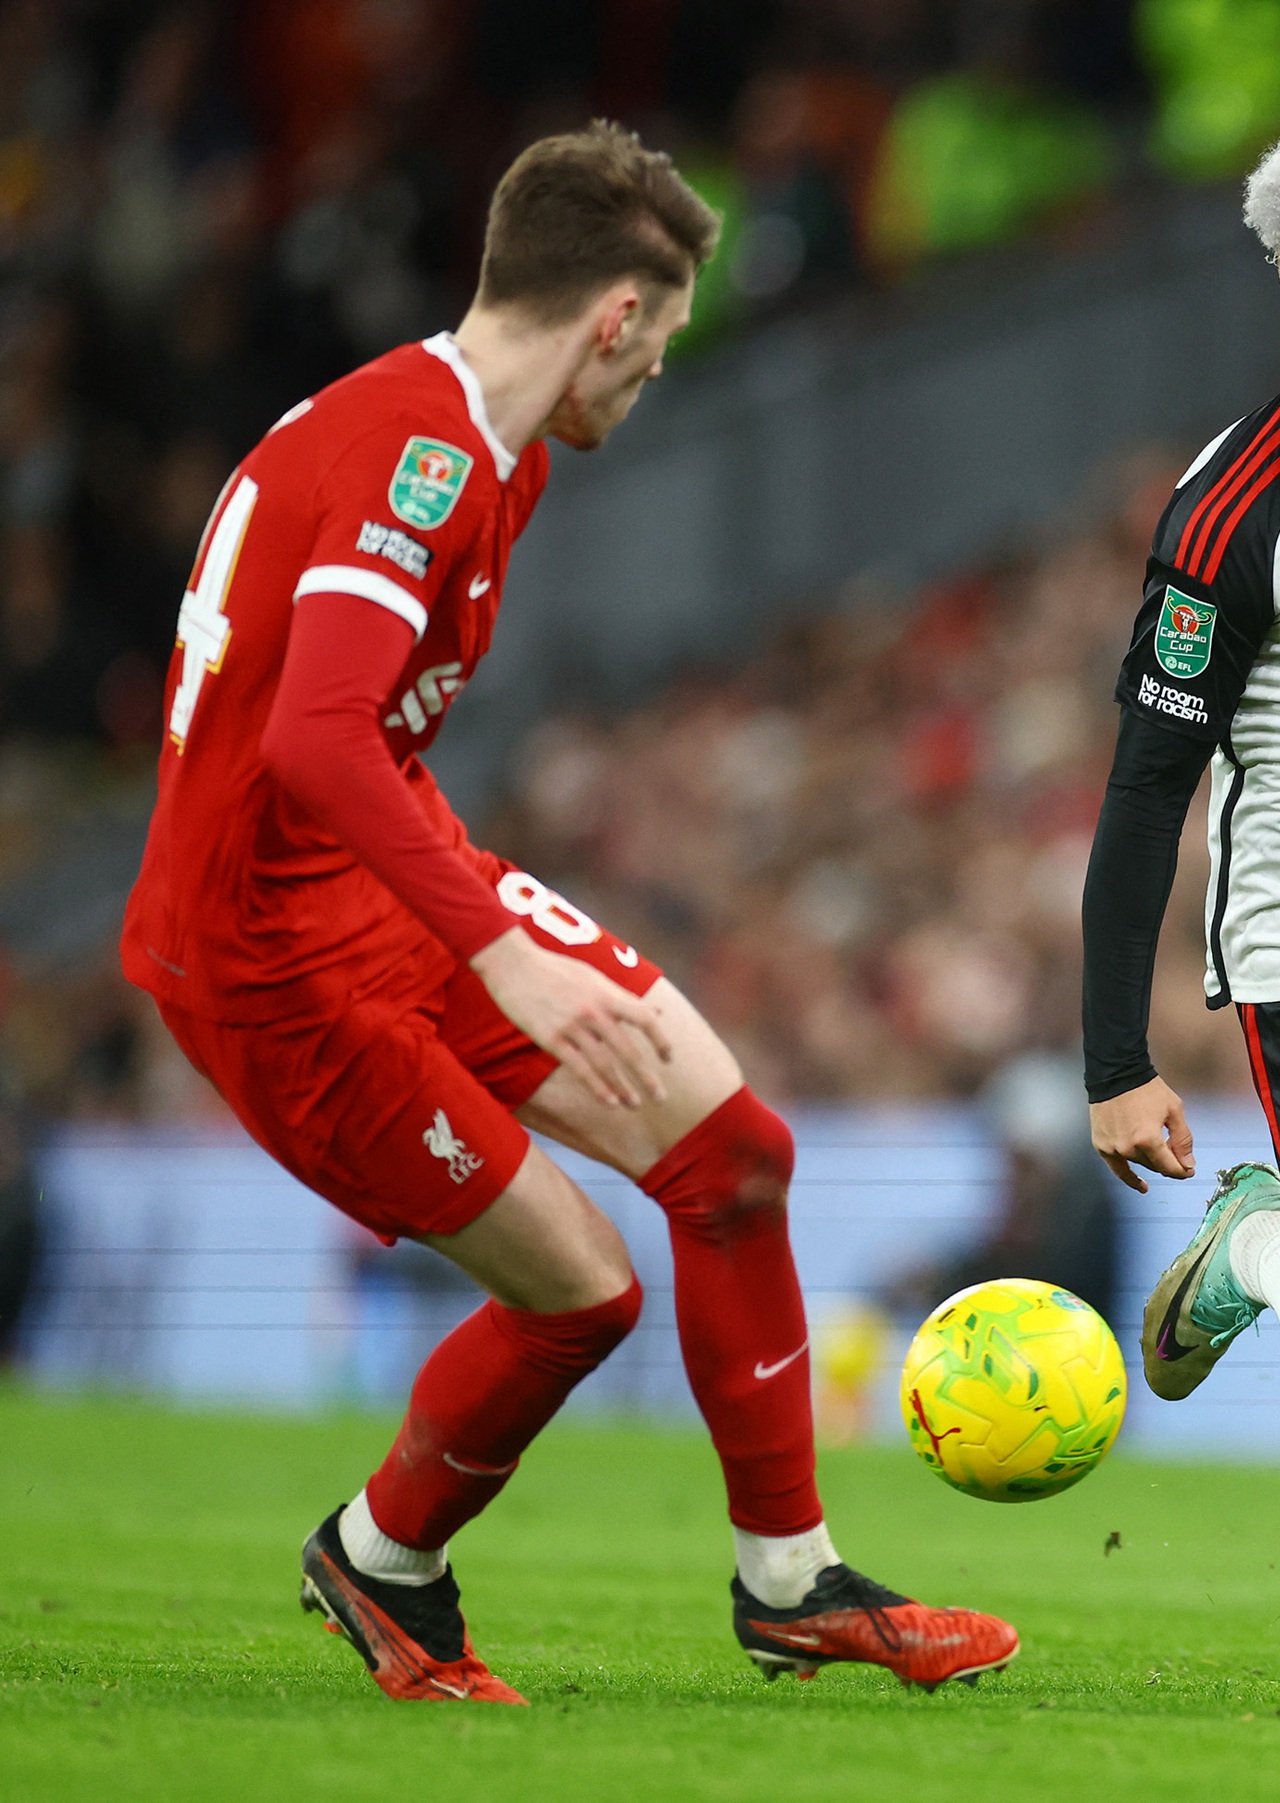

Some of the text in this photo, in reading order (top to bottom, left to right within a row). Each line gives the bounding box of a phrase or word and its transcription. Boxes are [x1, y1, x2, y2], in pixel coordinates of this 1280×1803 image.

[1160, 627, 1207, 643] Carabao
[1169, 640, 1194, 653] Cup
[1177, 661, 1193, 672] EFL
[1141, 673, 1204, 710] No room
[1138, 687, 1208, 724] for racism
[496, 871, 602, 945] 8
